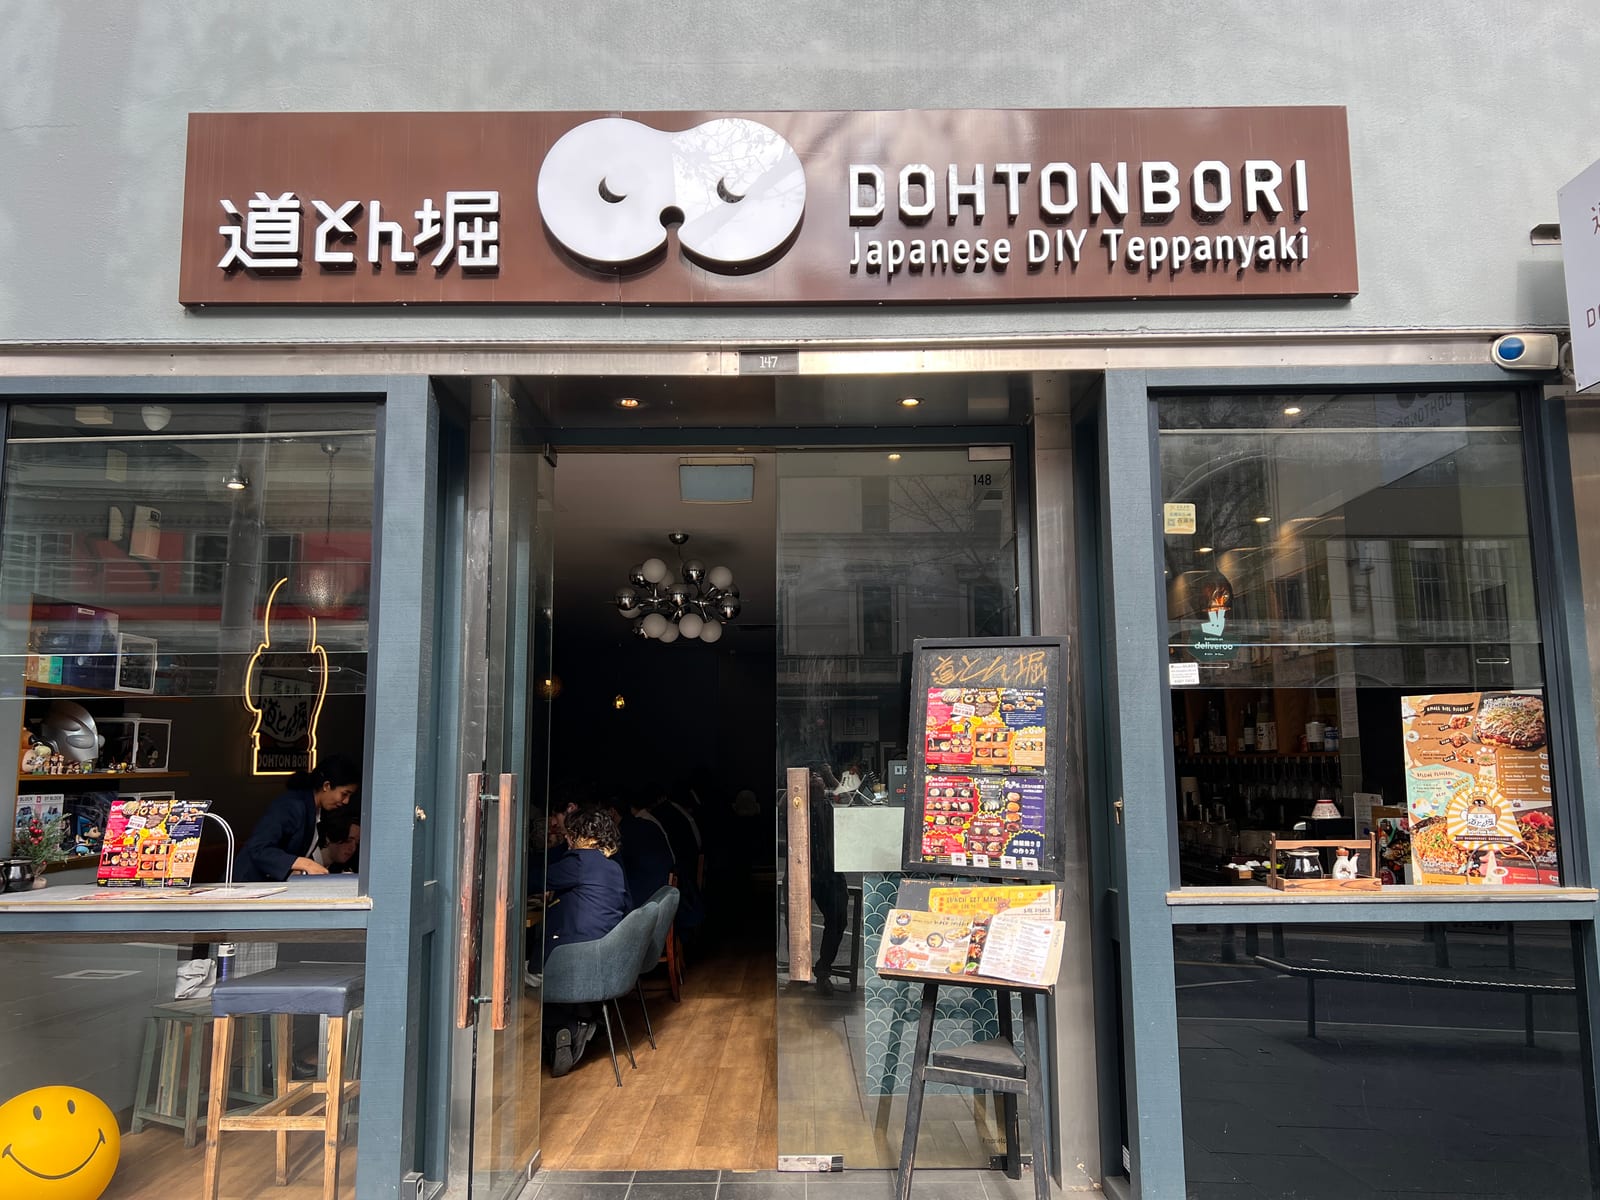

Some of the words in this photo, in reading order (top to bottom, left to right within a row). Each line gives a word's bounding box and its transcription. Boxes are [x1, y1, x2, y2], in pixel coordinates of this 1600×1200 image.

[849, 160, 1308, 221] DOHTONBORI
[216, 191, 499, 270] 道とん堀
[850, 231, 1011, 274] Japanese
[1027, 229, 1087, 265] DIY
[1104, 227, 1309, 271] Teppanyaki
[1586, 303, 1600, 328] D
[759, 356, 778, 368] 147
[973, 474, 992, 486] 148
[1194, 642, 1233, 650] deliveroo
[931, 651, 1048, 685] 道とん堀
